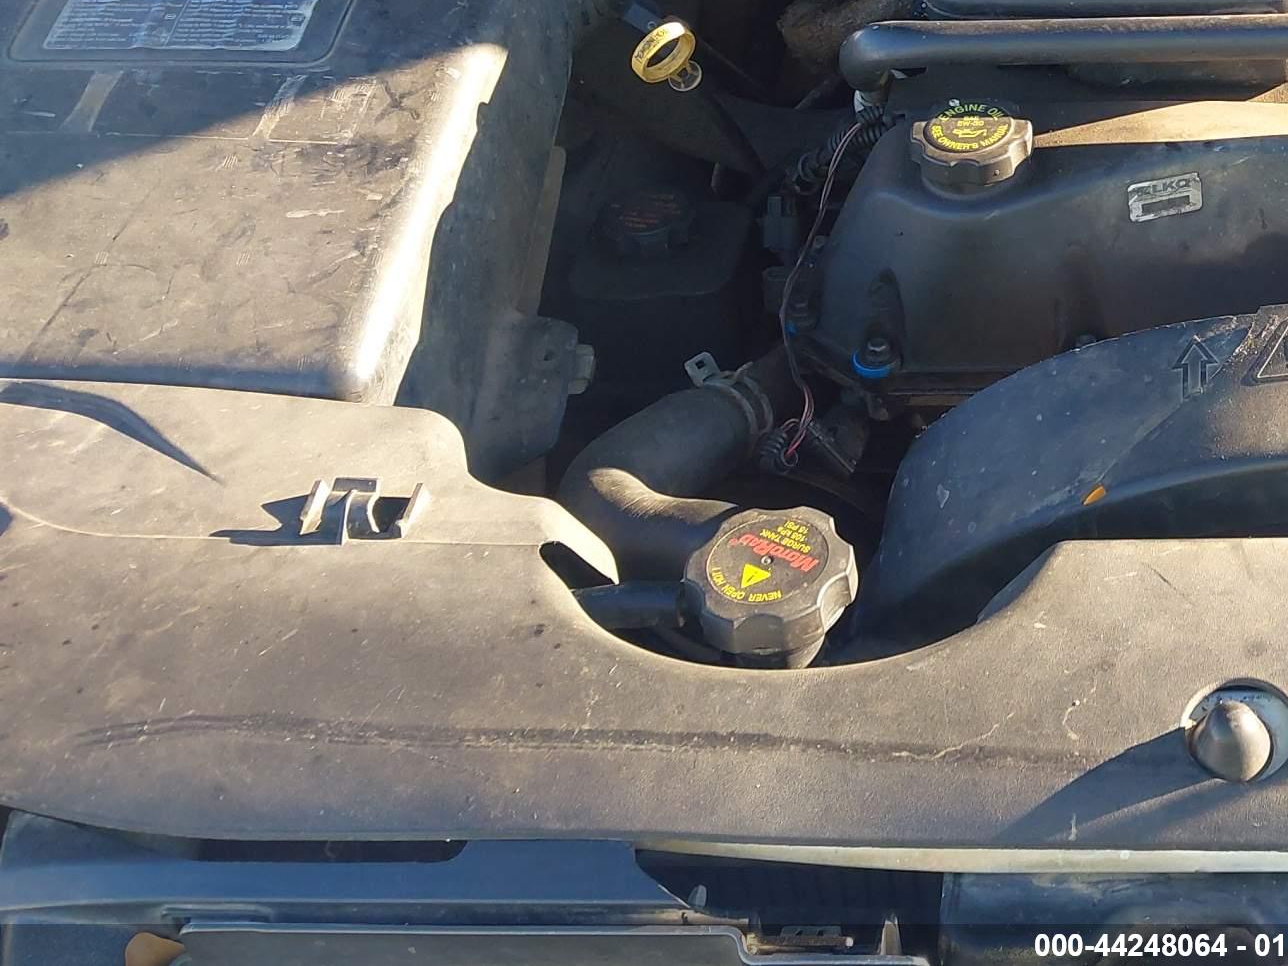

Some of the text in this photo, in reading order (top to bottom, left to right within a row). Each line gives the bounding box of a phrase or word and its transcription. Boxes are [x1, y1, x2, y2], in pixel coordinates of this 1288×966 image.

[939, 103, 1006, 122] ENGINE OIL
[931, 124, 1009, 150] SEE OWNER'S MANUAL
[783, 520, 799, 531] PSI
[759, 528, 812, 554] SURGE TANK
[721, 583, 746, 601] OPEN
[748, 590, 783, 603] NEVER
